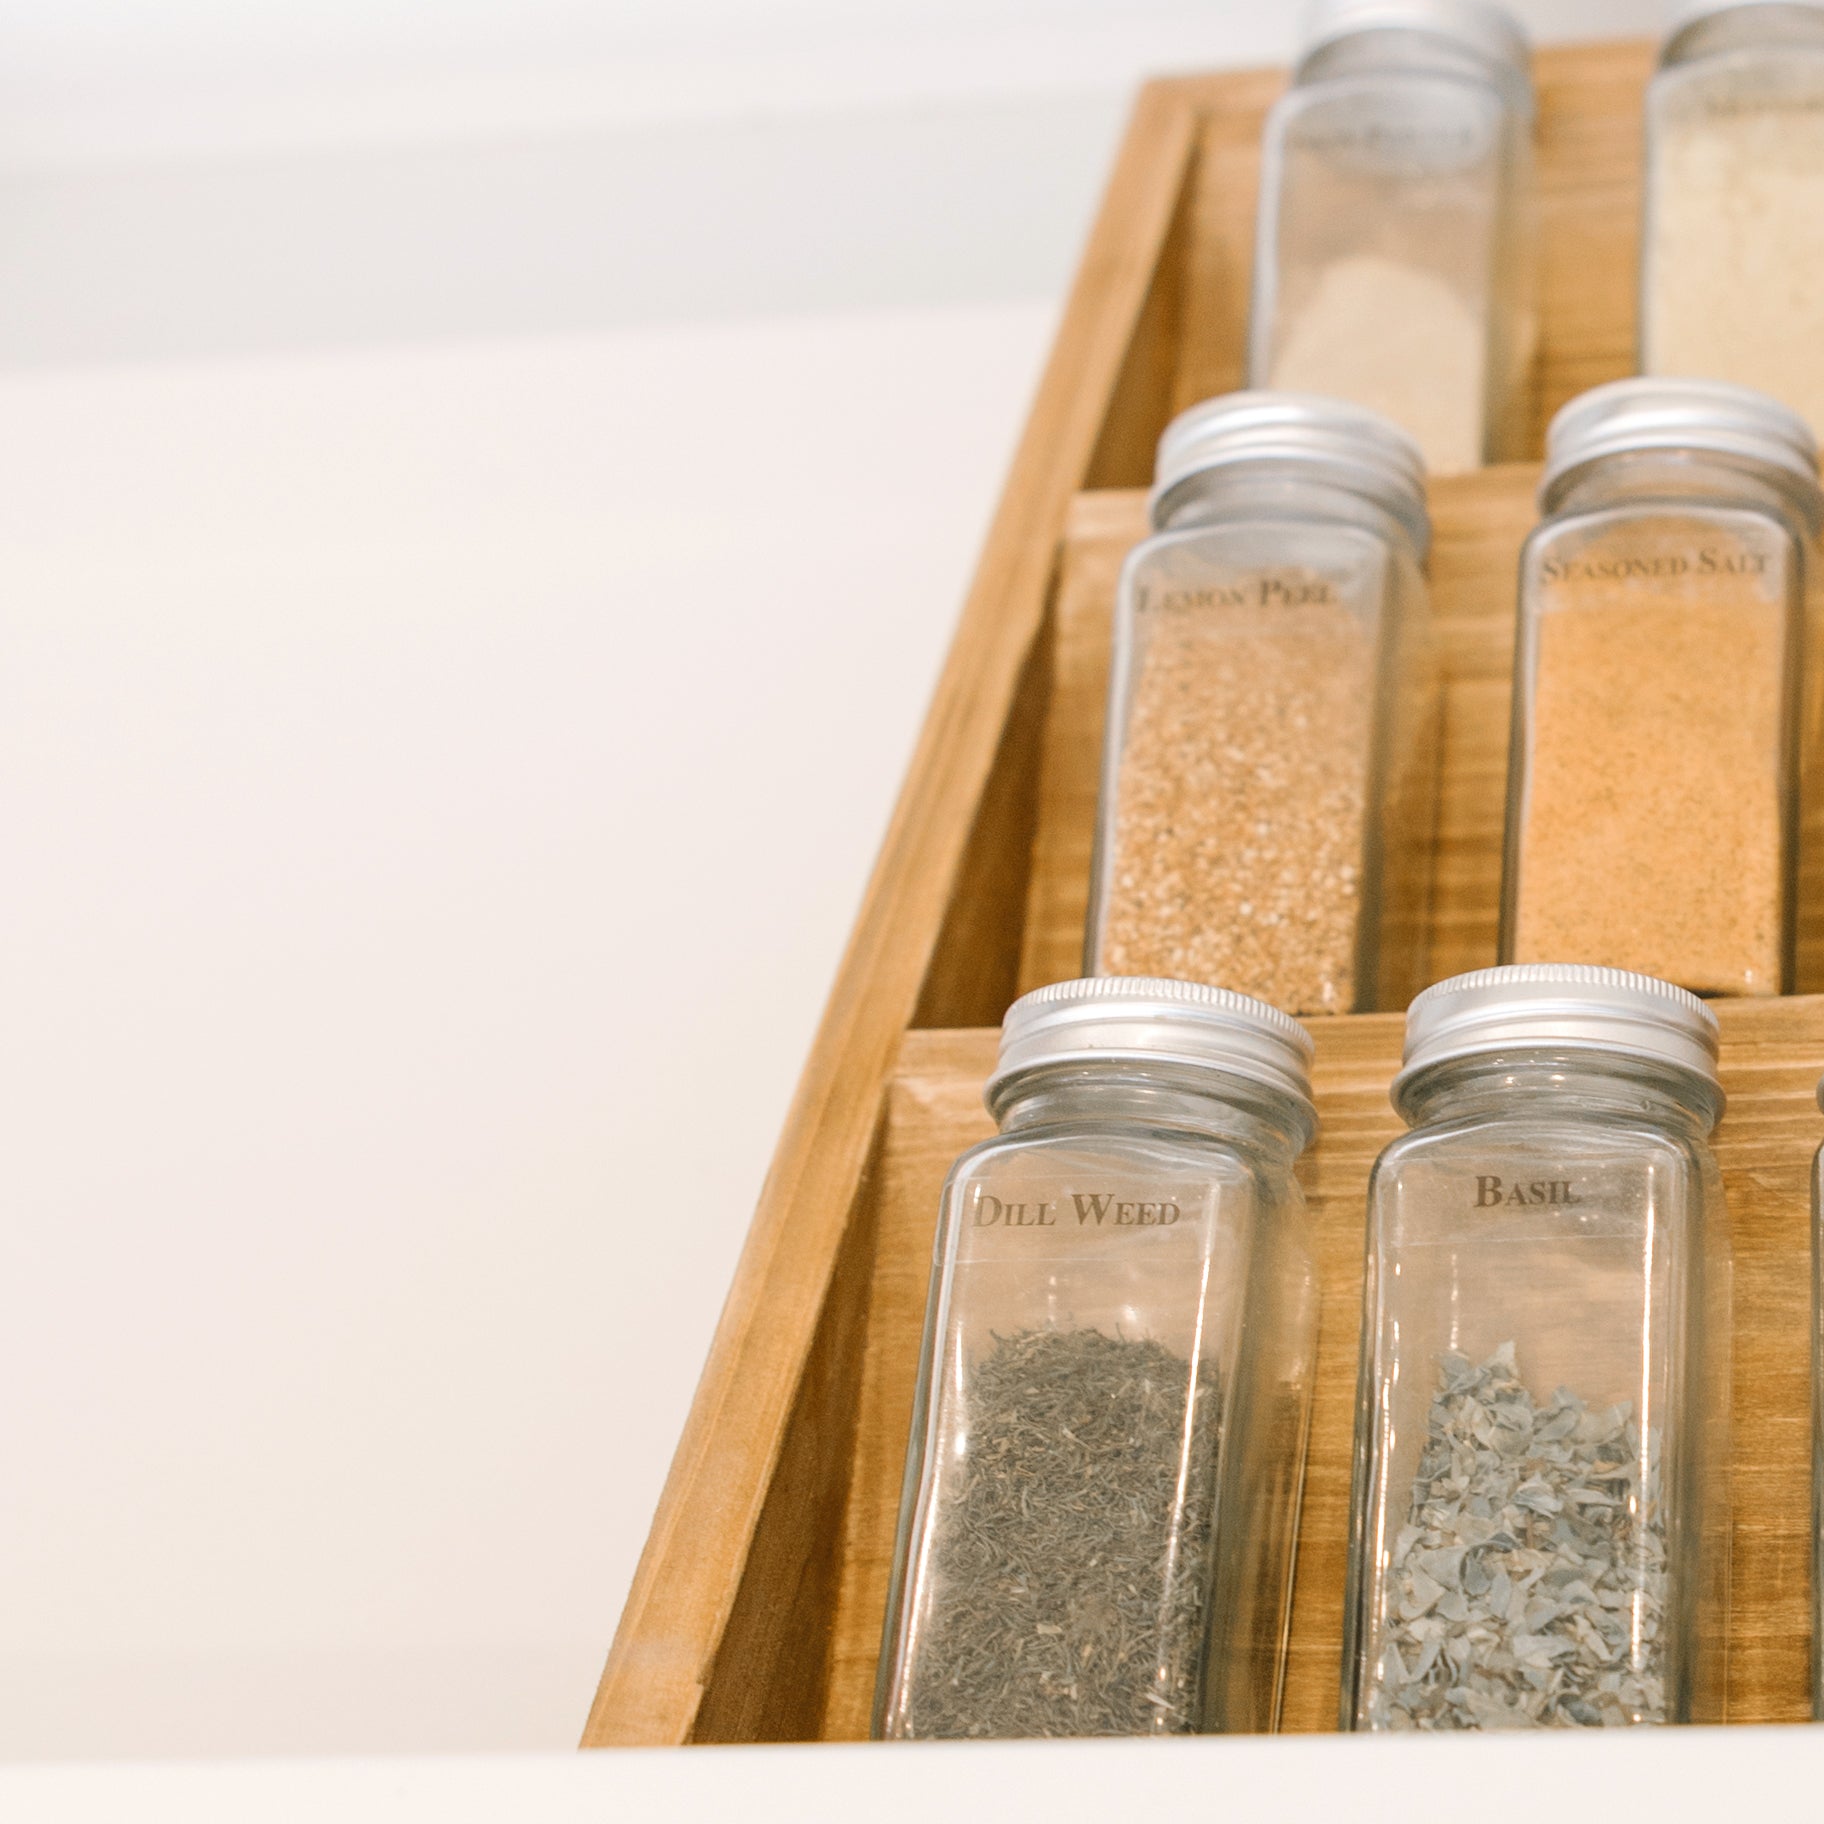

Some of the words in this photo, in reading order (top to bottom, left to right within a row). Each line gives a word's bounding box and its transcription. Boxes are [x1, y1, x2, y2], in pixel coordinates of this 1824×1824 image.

[1697, 546, 1768, 575] SALT
[1473, 1174, 1581, 1209] BASIL
[972, 1194, 1056, 1227] DILL
[1071, 1192, 1181, 1227] WEED
